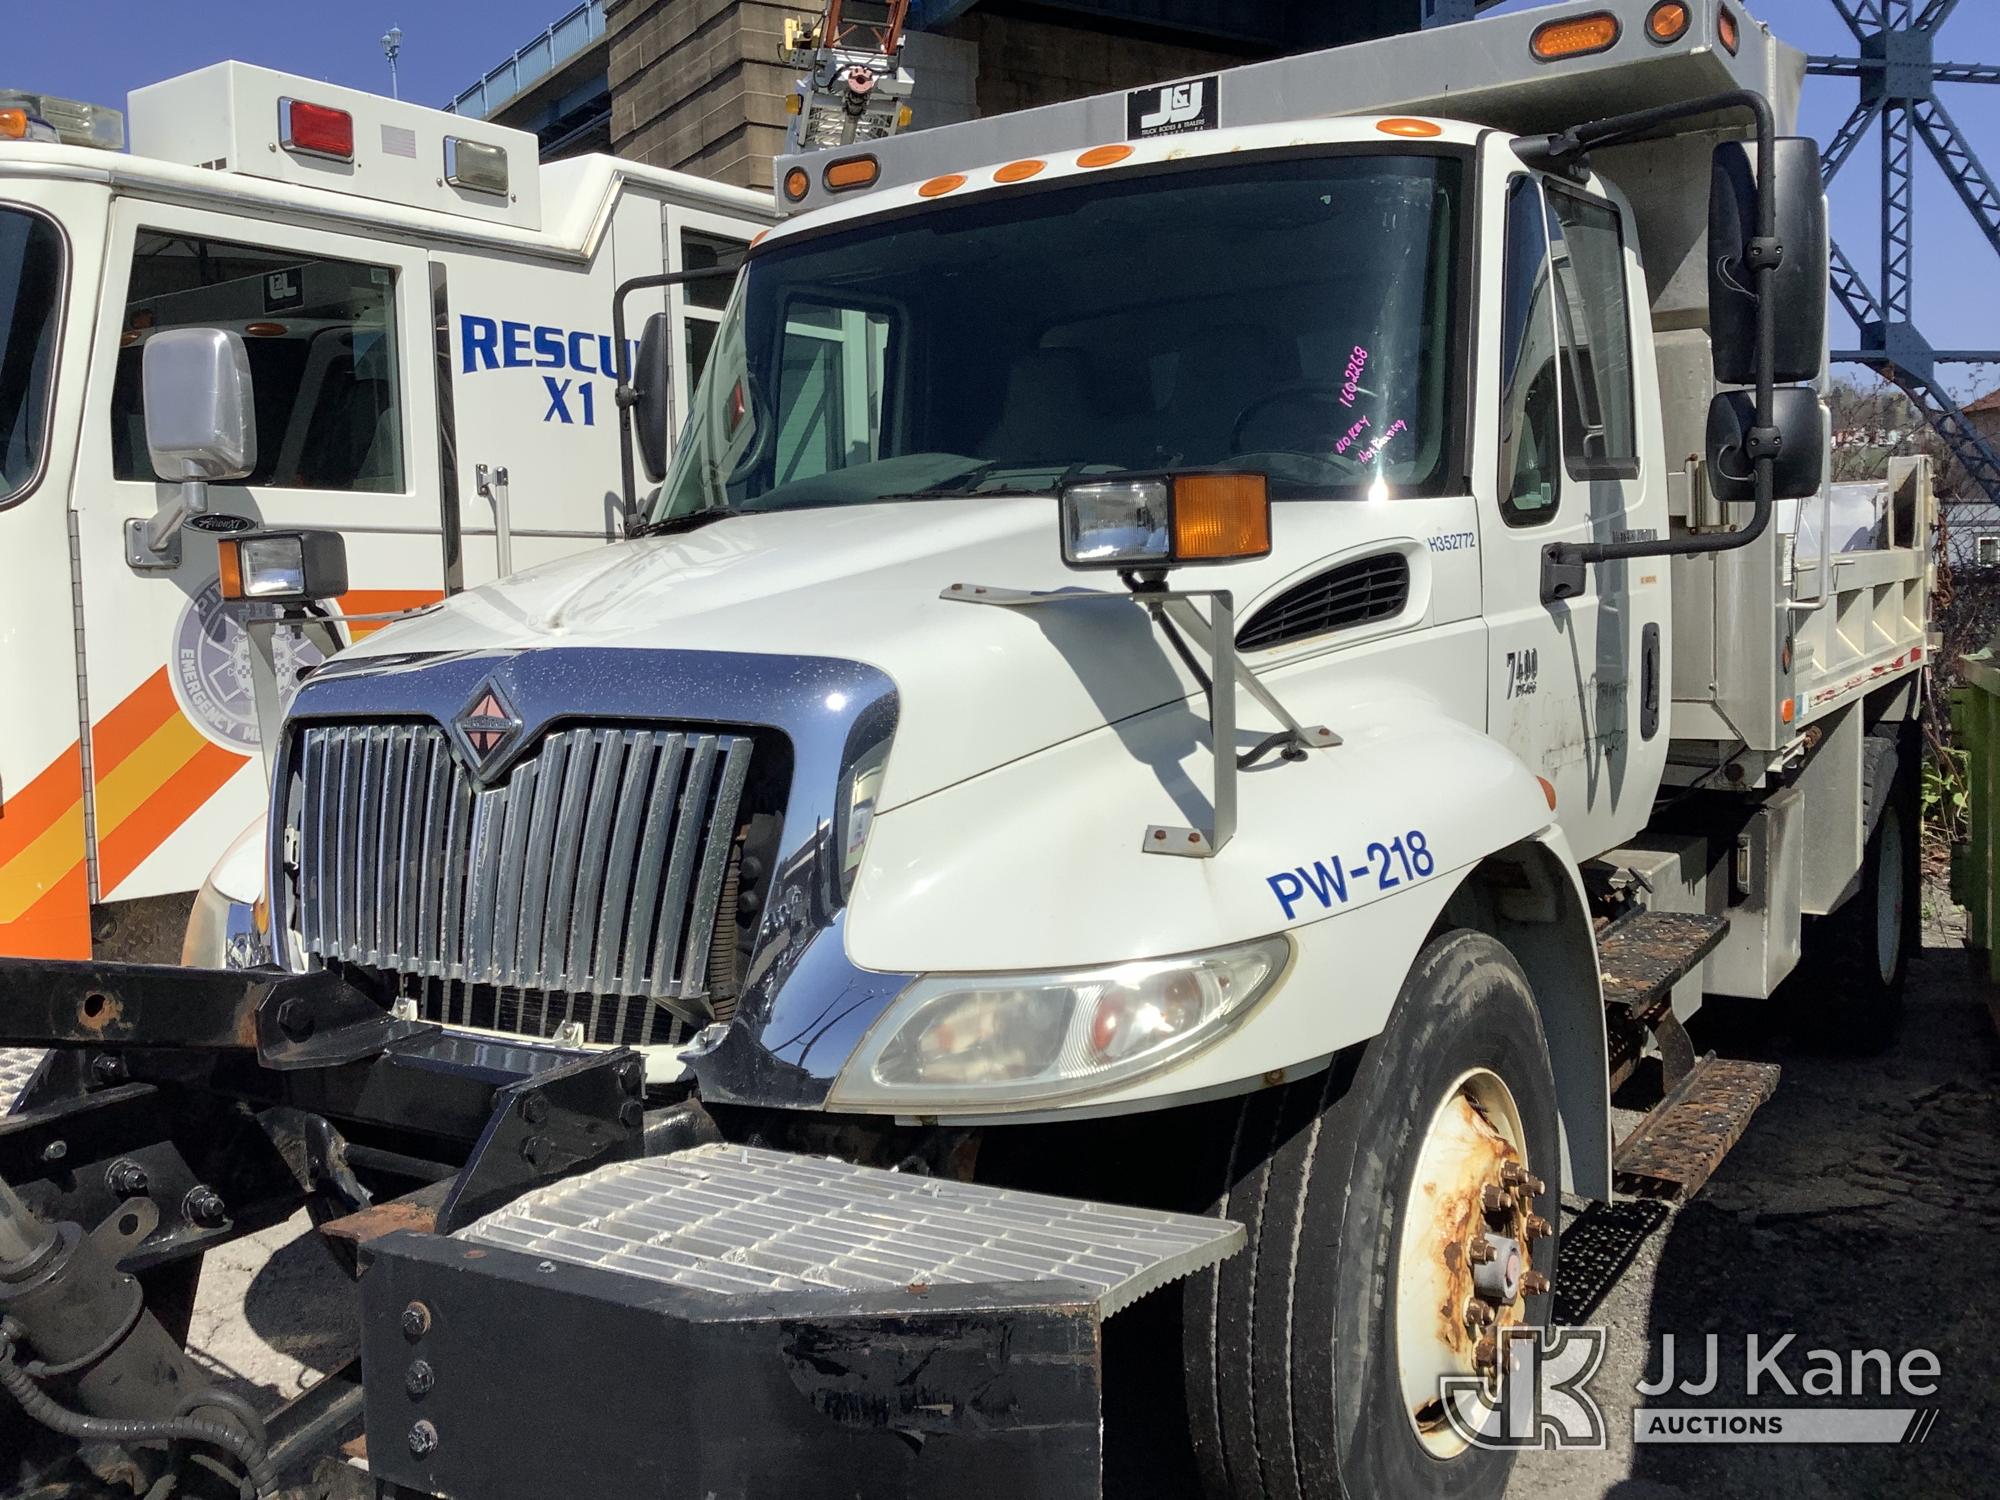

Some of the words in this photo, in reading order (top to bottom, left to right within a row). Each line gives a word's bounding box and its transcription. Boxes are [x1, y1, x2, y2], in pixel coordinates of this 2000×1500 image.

[1141, 82, 1203, 128] J&J
[460, 314, 640, 381] RESCU
[1338, 345, 1368, 407] 1602268
[542, 375, 595, 426] X1
[1427, 532, 1476, 552] H352772
[180, 648, 238, 735] EMERGENCY
[1506, 648, 1538, 700] 7400
[1266, 830, 1435, 920] PW-218
